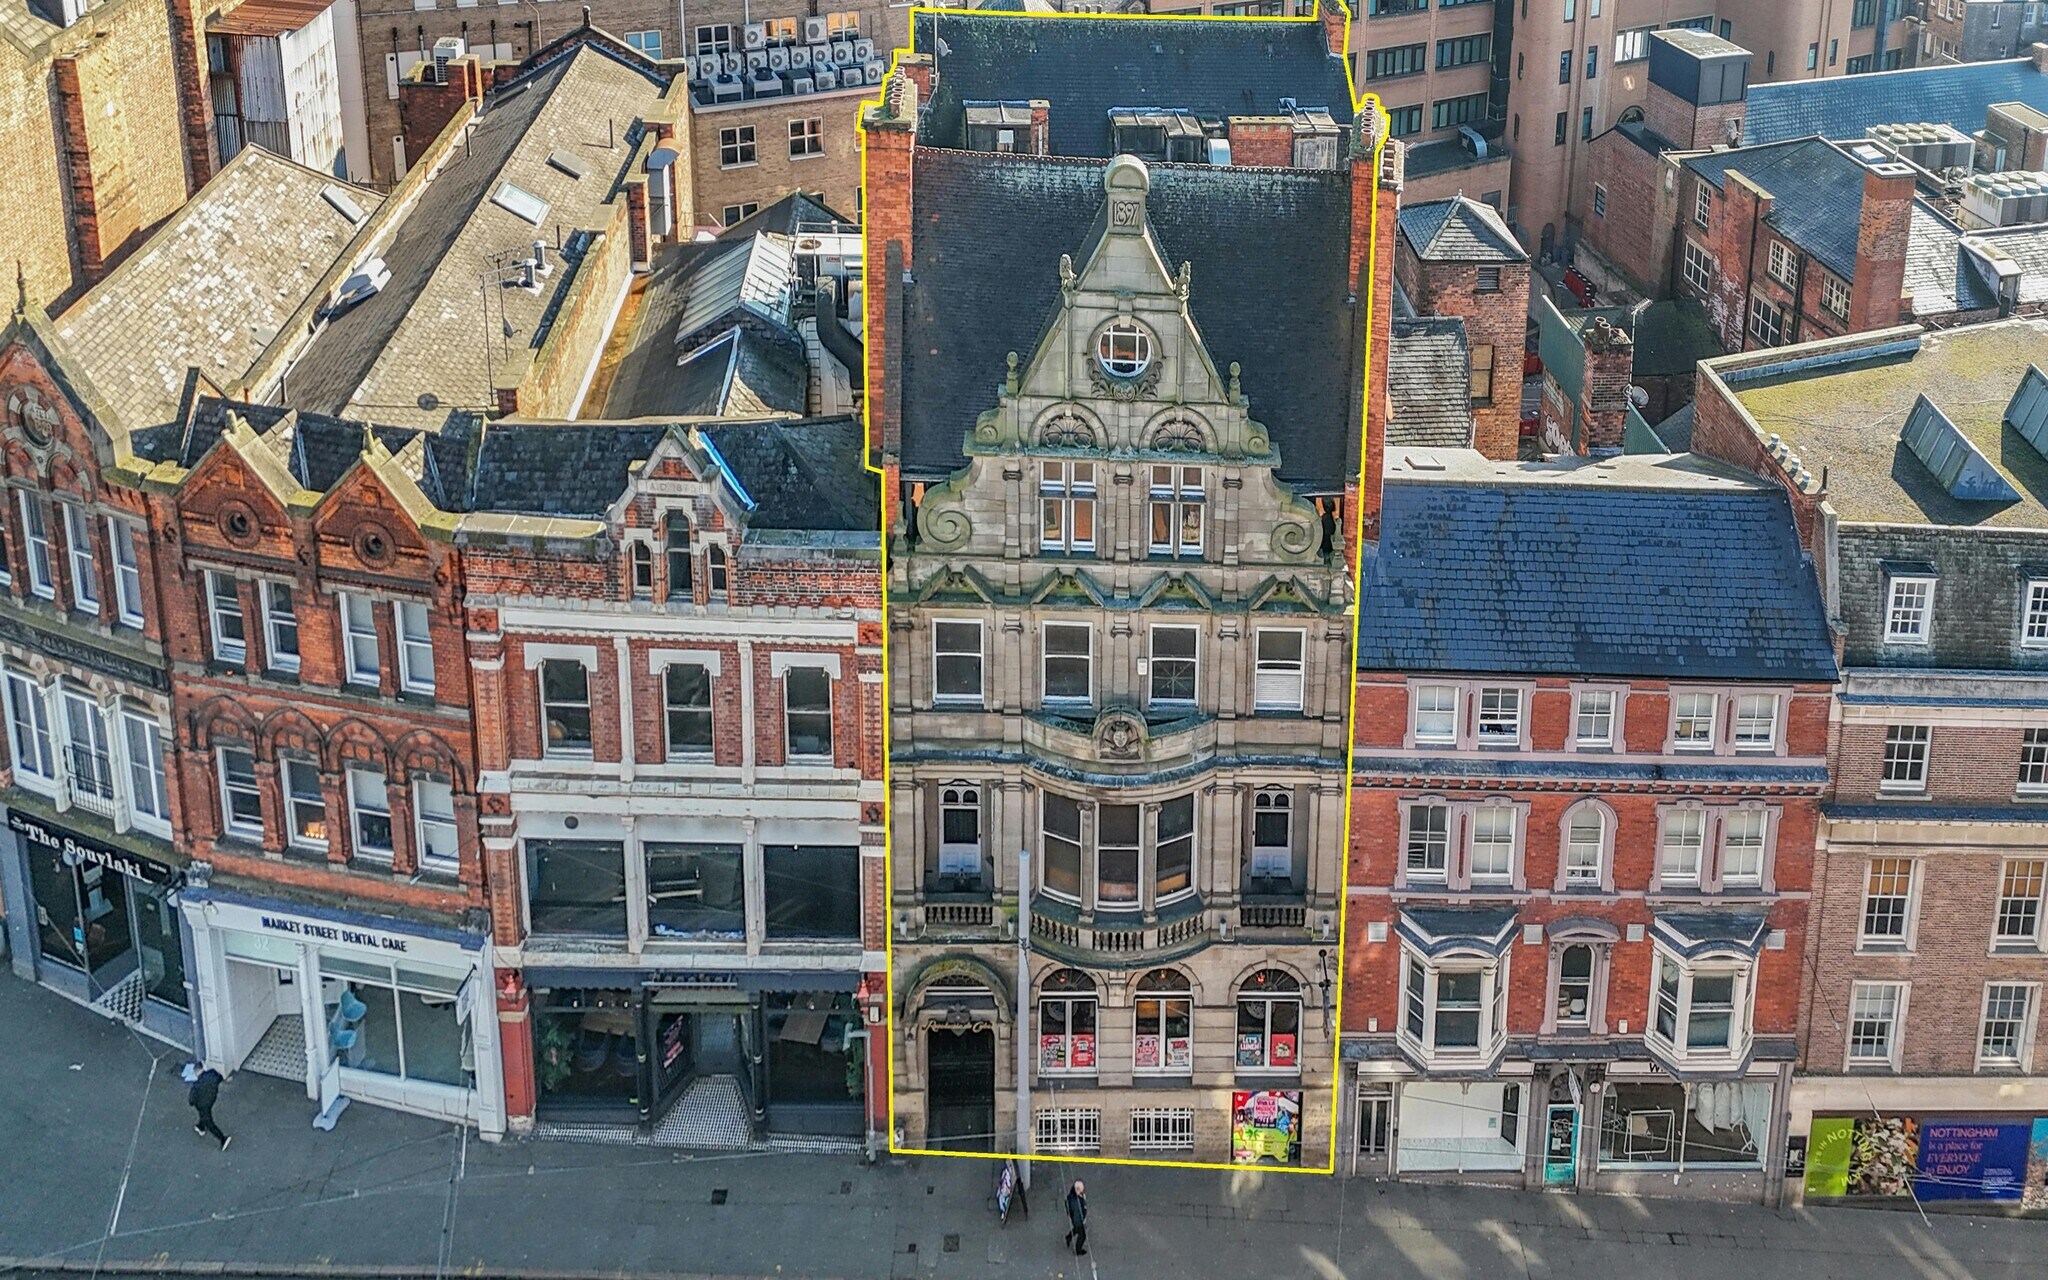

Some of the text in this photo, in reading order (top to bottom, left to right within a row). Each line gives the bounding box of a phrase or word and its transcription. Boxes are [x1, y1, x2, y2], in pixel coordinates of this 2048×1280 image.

[1113, 201, 1140, 226] 1897
[25, 823, 60, 850] The
[64, 837, 143, 881] Souvlaki
[261, 916, 408, 953] MARKET STREET DENTAL CARE
[1929, 1128, 1999, 1138] NOTTINGHAM
[1945, 1141, 1969, 1152] place
[1970, 1141, 1983, 1150] for
[1926, 1153, 1982, 1163] EVERYONE
[1936, 1165, 1970, 1175] ENJOY
